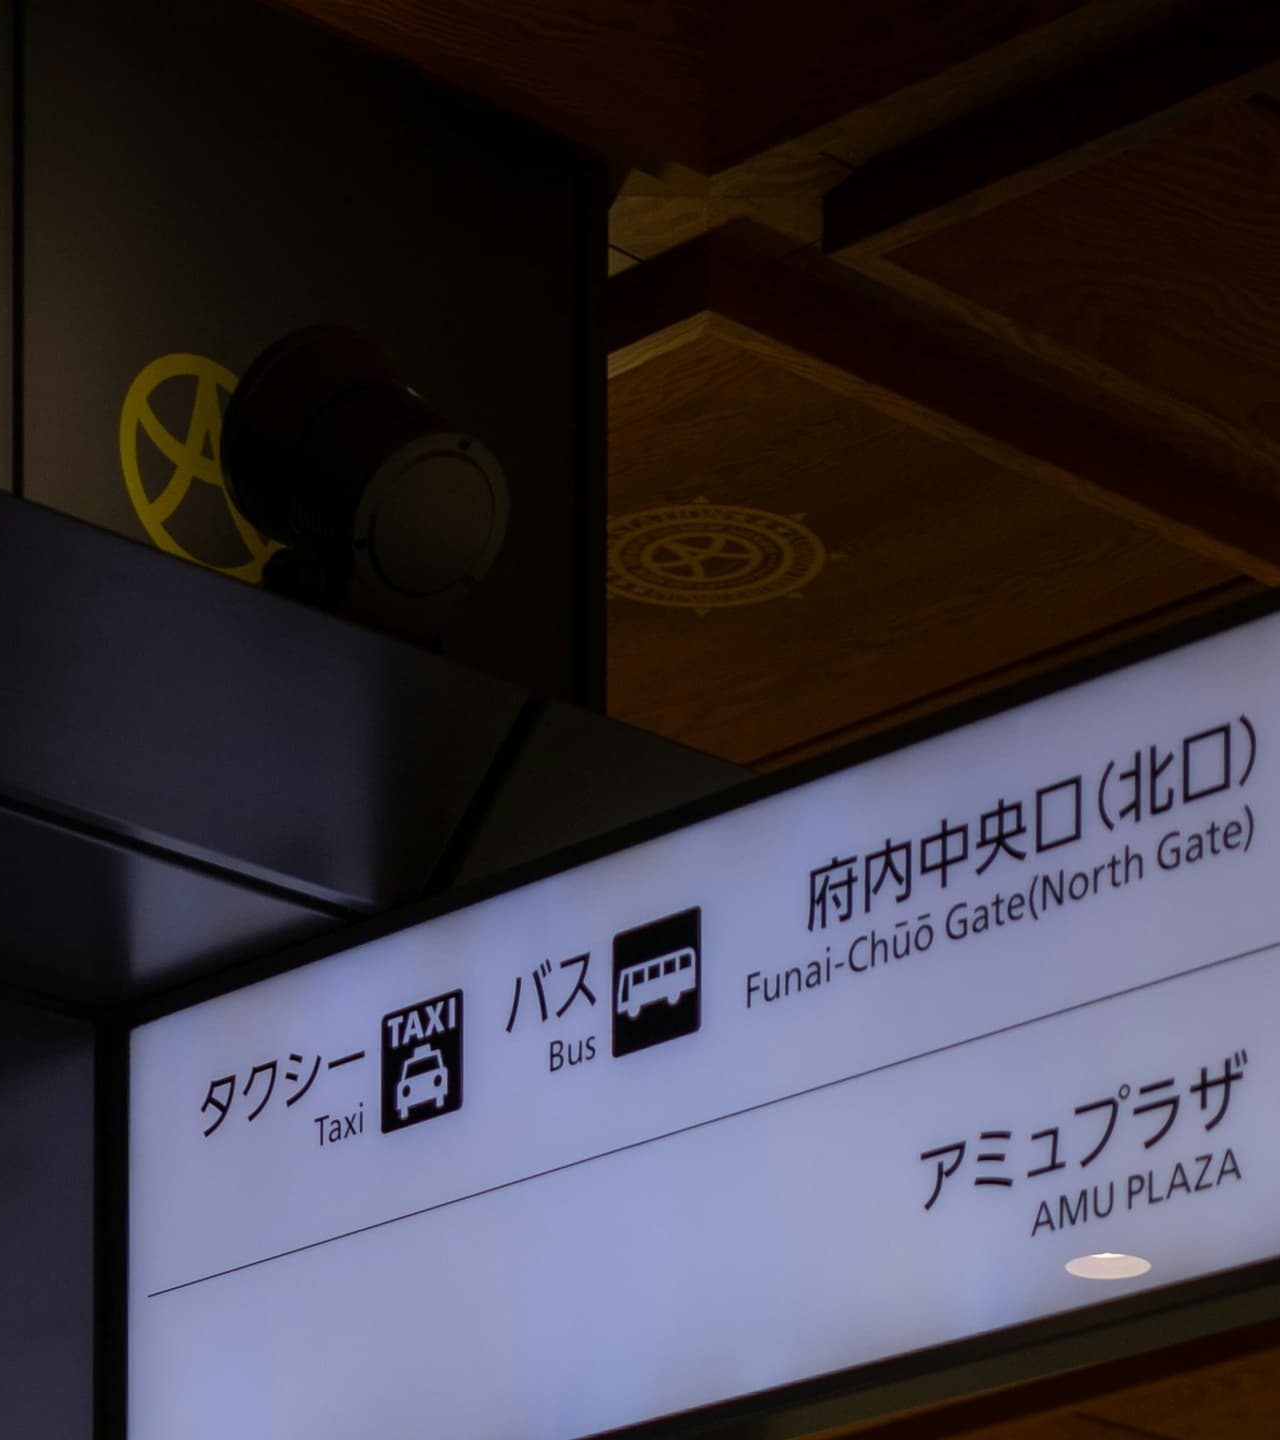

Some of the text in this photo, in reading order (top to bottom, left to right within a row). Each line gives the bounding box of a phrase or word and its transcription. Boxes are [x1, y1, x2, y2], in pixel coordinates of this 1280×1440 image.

[807, 714, 1257, 932] 府内中央口（北口）
[746, 805, 1256, 1008] Funai-Chūō Gate(North Gate)
[387, 997, 457, 1050] TAXI
[505, 951, 597, 1034] バス
[200, 1050, 366, 1138] タクシー
[549, 1034, 597, 1073] Bus
[314, 1103, 365, 1147] Taxi
[920, 1048, 1248, 1211] アミュプラザ
[1031, 1148, 1242, 1238] AMU PLAZA
